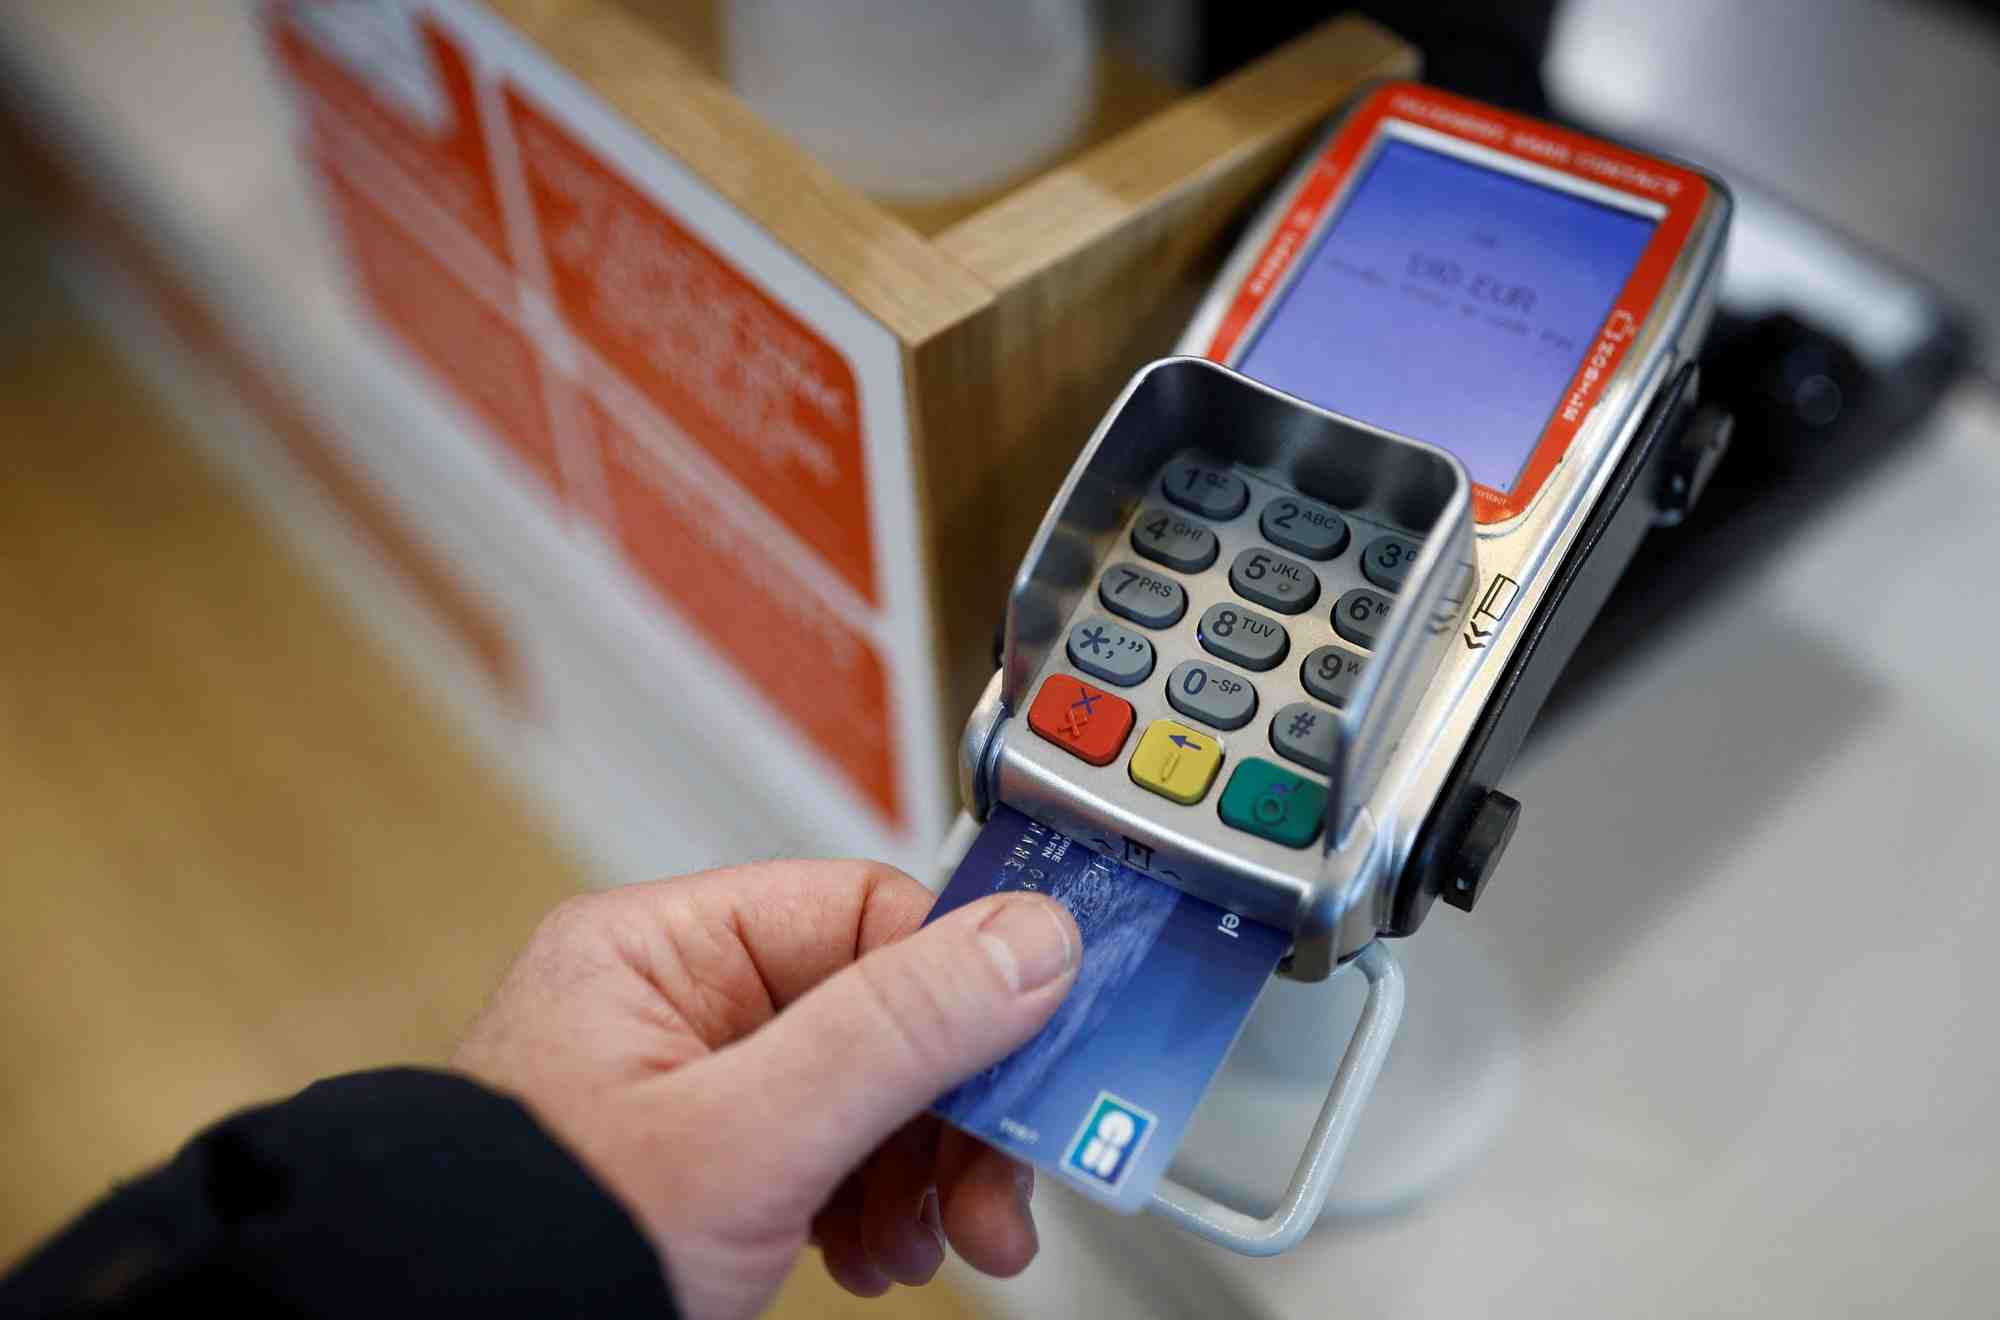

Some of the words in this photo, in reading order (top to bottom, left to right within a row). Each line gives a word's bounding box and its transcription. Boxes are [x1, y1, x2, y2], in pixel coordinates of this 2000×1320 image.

[1185, 468, 1201, 491] 1
[1146, 517, 1170, 541] 4
[1174, 523, 1203, 541] GHI
[1275, 502, 1299, 529] 2
[1301, 509, 1337, 531] ABC
[1245, 555, 1270, 580] 5
[1271, 563, 1302, 582] JKL
[1378, 543, 1402, 568] 3
[1115, 569, 1140, 594] 7
[1139, 577, 1173, 598] PRS
[1350, 596, 1373, 620] 6
[1212, 610, 1237, 637] 8
[1241, 618, 1276, 640] TUV
[1317, 654, 1343, 680] 9
[1182, 668, 1208, 695] 0
[1289, 711, 1316, 739] #
[1041, 841, 1057, 858] FIN
